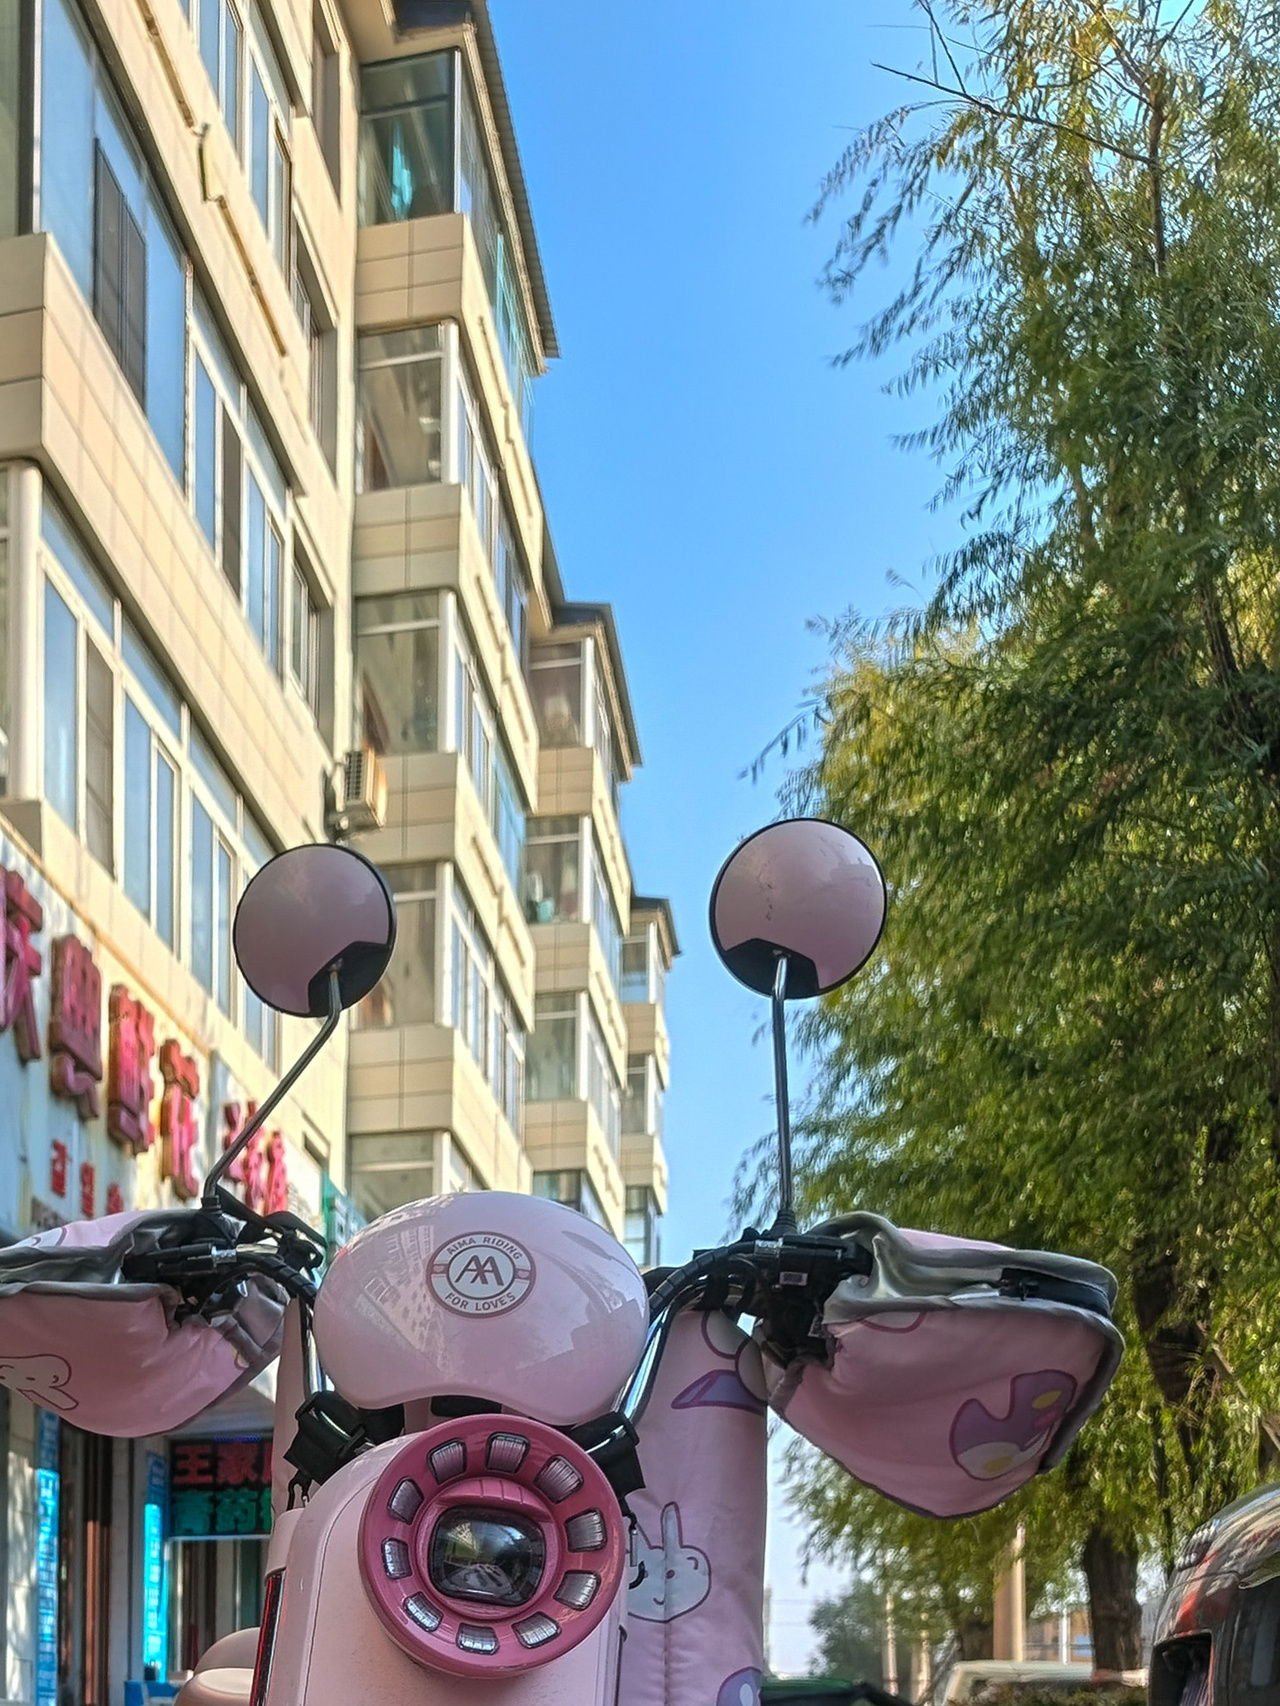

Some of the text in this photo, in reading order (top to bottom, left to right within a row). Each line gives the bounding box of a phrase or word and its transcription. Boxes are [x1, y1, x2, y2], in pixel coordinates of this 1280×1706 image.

[446, 1236, 523, 1260] AIMA RIDING
[444, 1291, 469, 1310] FOR
